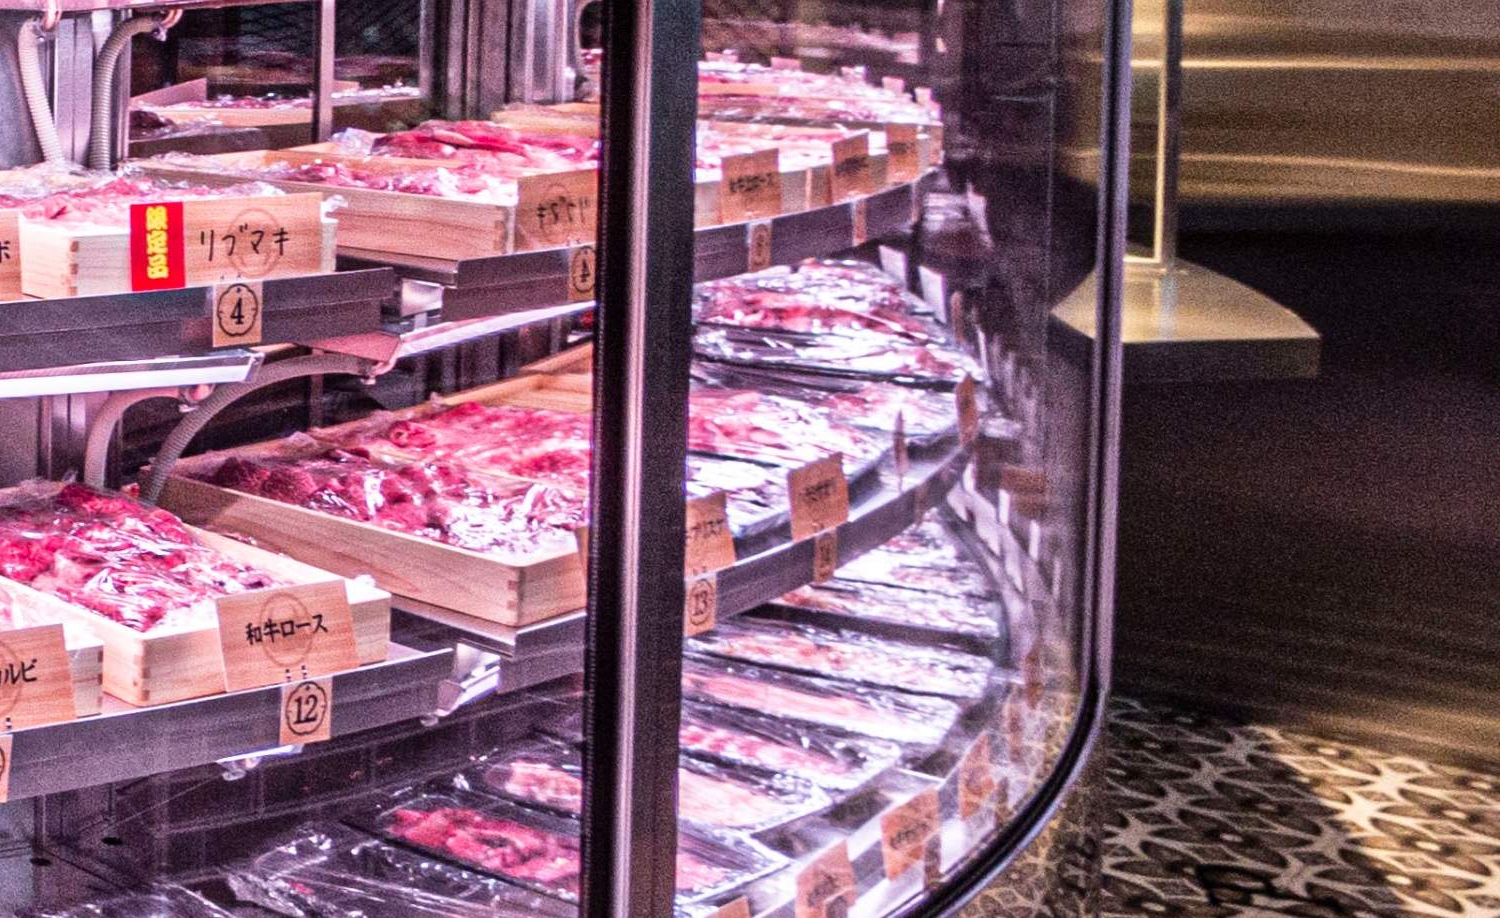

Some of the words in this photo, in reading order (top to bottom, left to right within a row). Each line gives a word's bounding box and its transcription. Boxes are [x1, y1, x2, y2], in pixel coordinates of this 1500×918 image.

[145, 206, 169, 279] 限定品
[200, 223, 290, 262] リブマキ
[230, 297, 245, 325] 4
[693, 590, 708, 616] 13
[245, 613, 329, 646] 和牛ロース
[293, 694, 319, 725] 12
